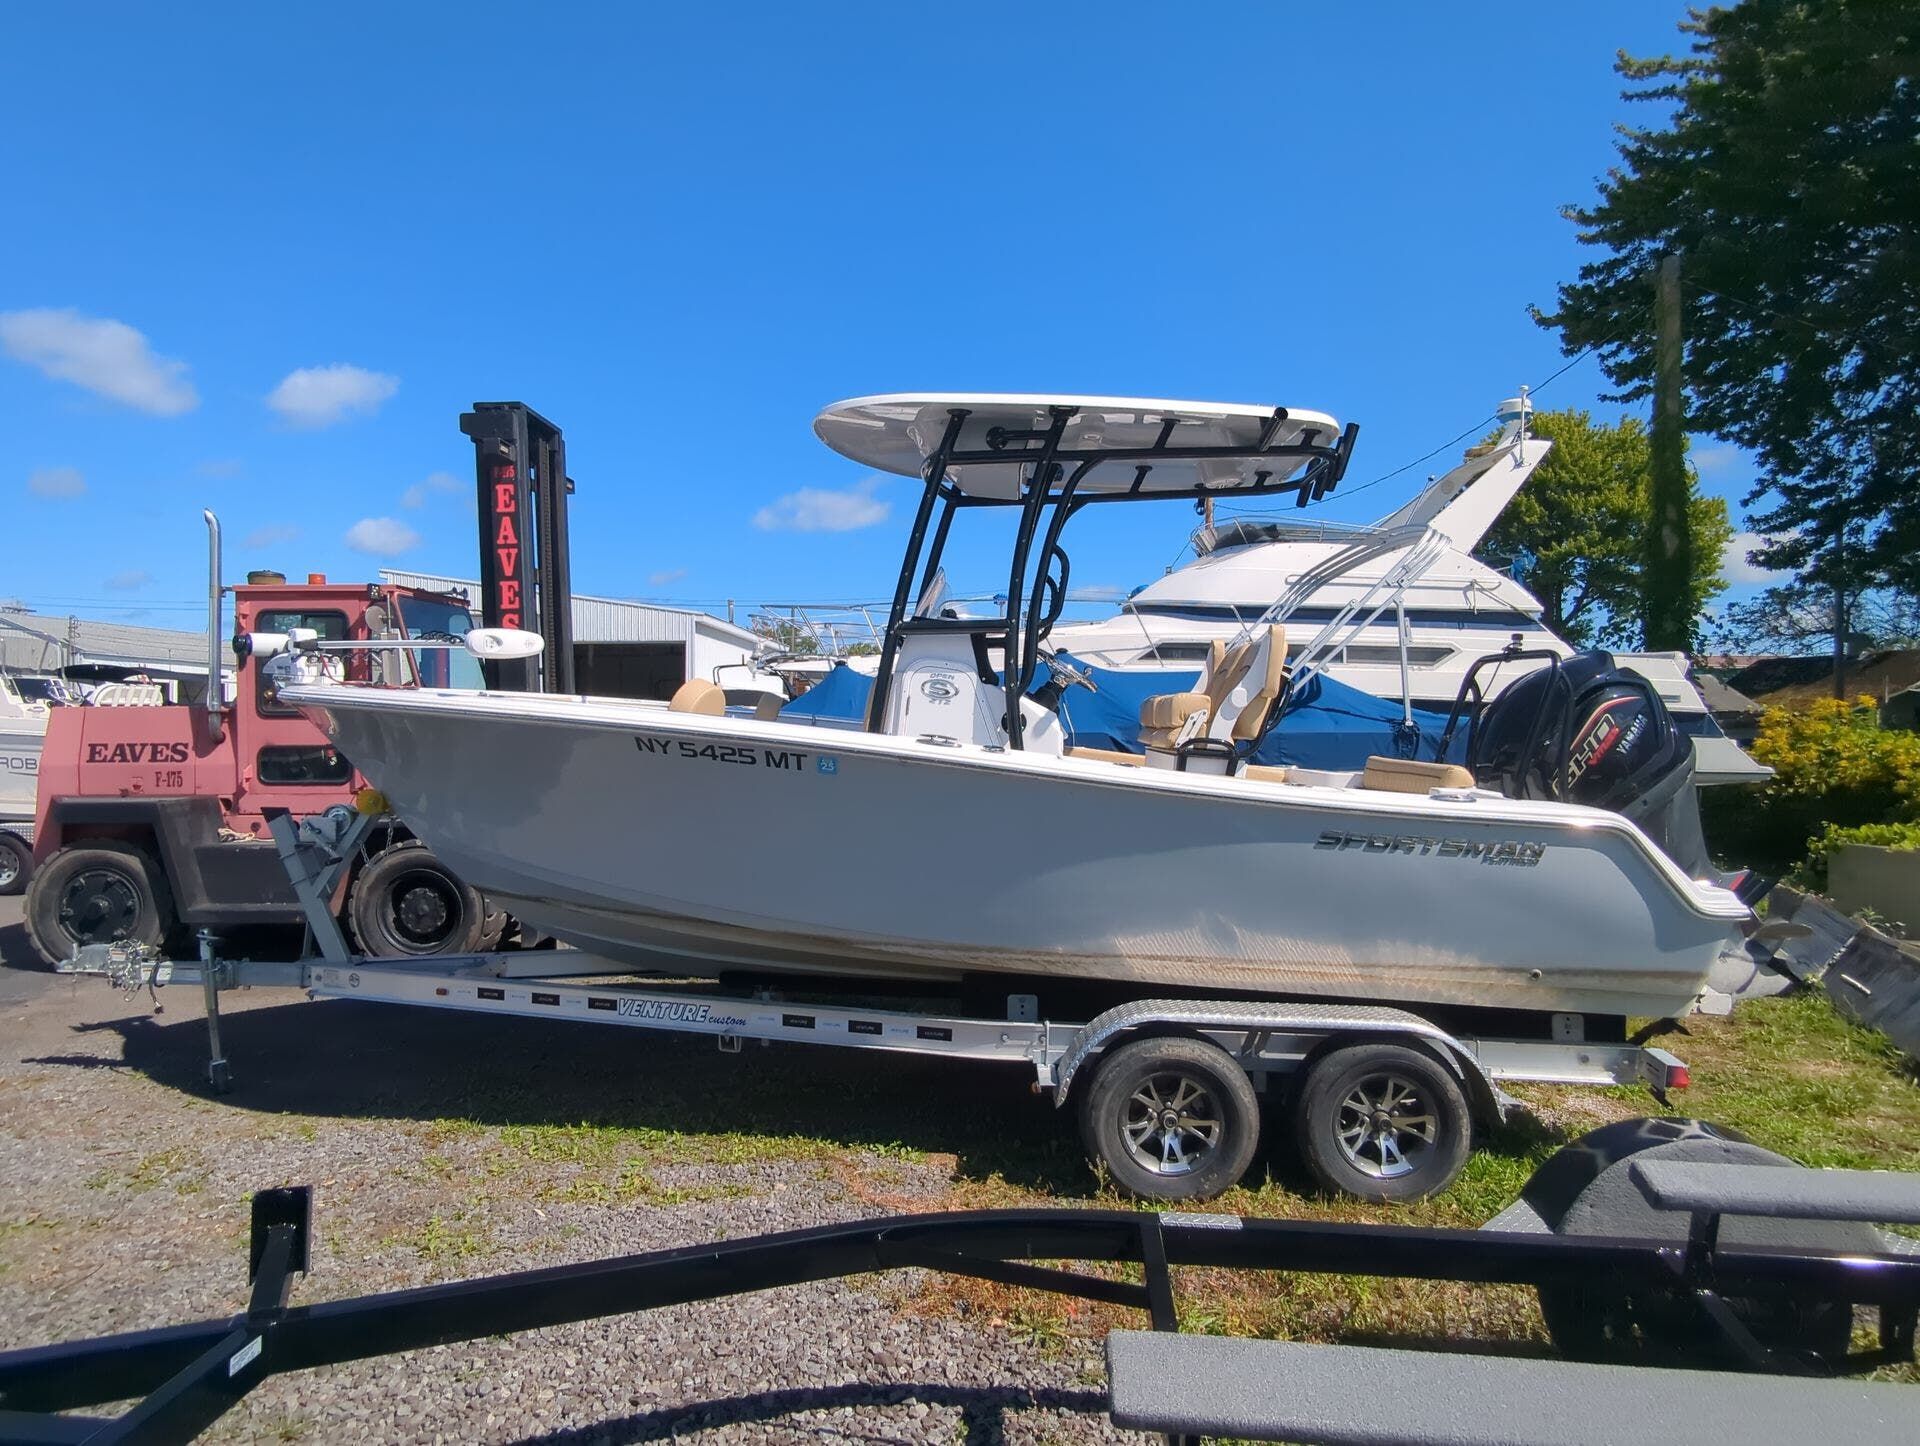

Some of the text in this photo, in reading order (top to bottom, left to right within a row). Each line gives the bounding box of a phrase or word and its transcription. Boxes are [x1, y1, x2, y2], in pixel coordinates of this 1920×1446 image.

[495, 484, 520, 629] EAVES
[1616, 714, 1648, 754] YAMAHA
[86, 742, 189, 763] EAVES
[634, 736, 807, 771] NY 5425 MT
[155, 771, 183, 788] F-175
[1314, 830, 1547, 859] SPORTSMAN
[618, 998, 747, 1026] VENTURE custom
